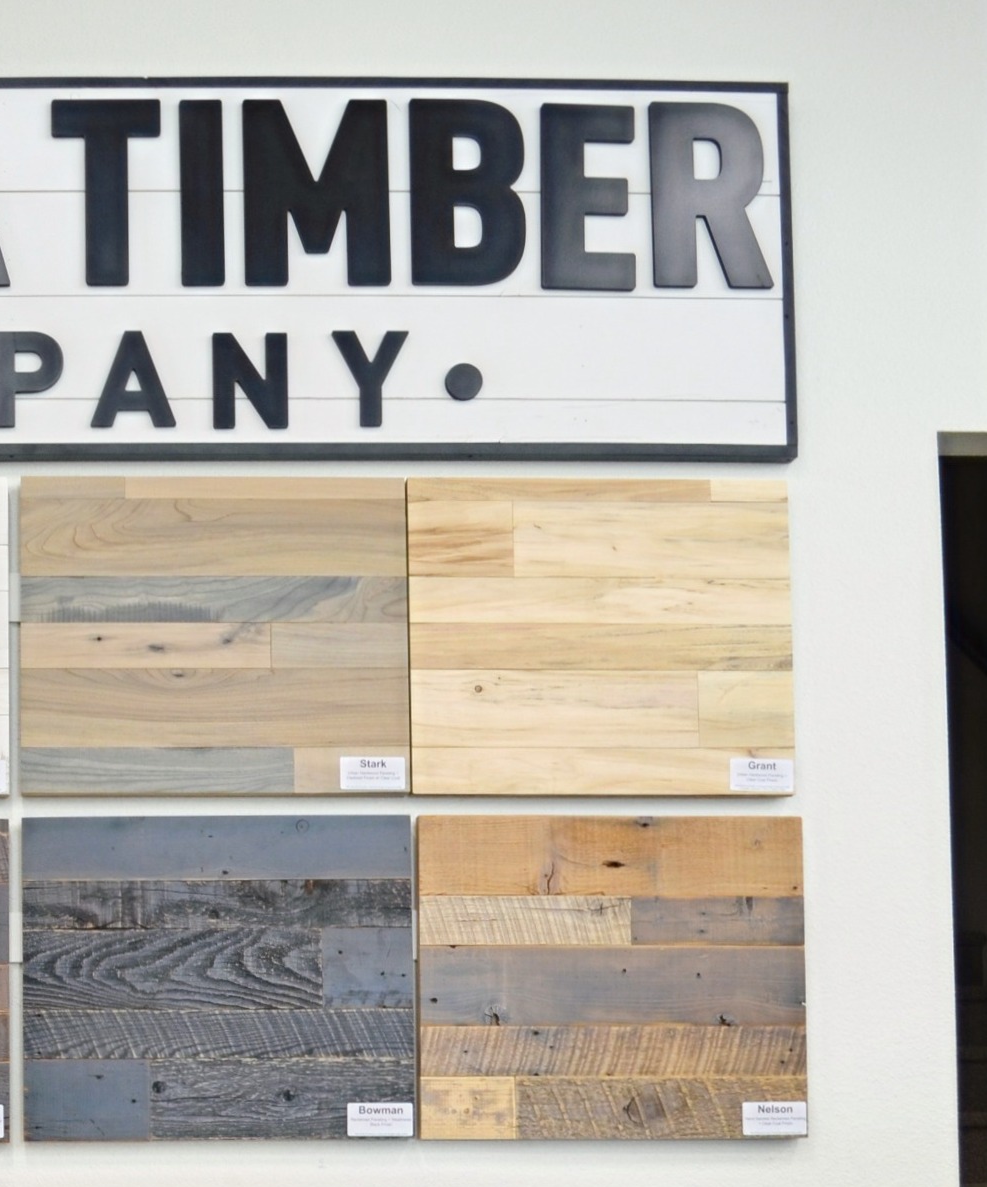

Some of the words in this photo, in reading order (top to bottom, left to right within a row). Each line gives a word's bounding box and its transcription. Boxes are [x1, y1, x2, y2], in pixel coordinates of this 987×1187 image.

[50, 95, 775, 294] TIMBER
[360, 759, 387, 769] Stark
[748, 761, 777, 770] Grant
[358, 1105, 404, 1115] Bowman
[757, 1105, 793, 1114] Nelson
